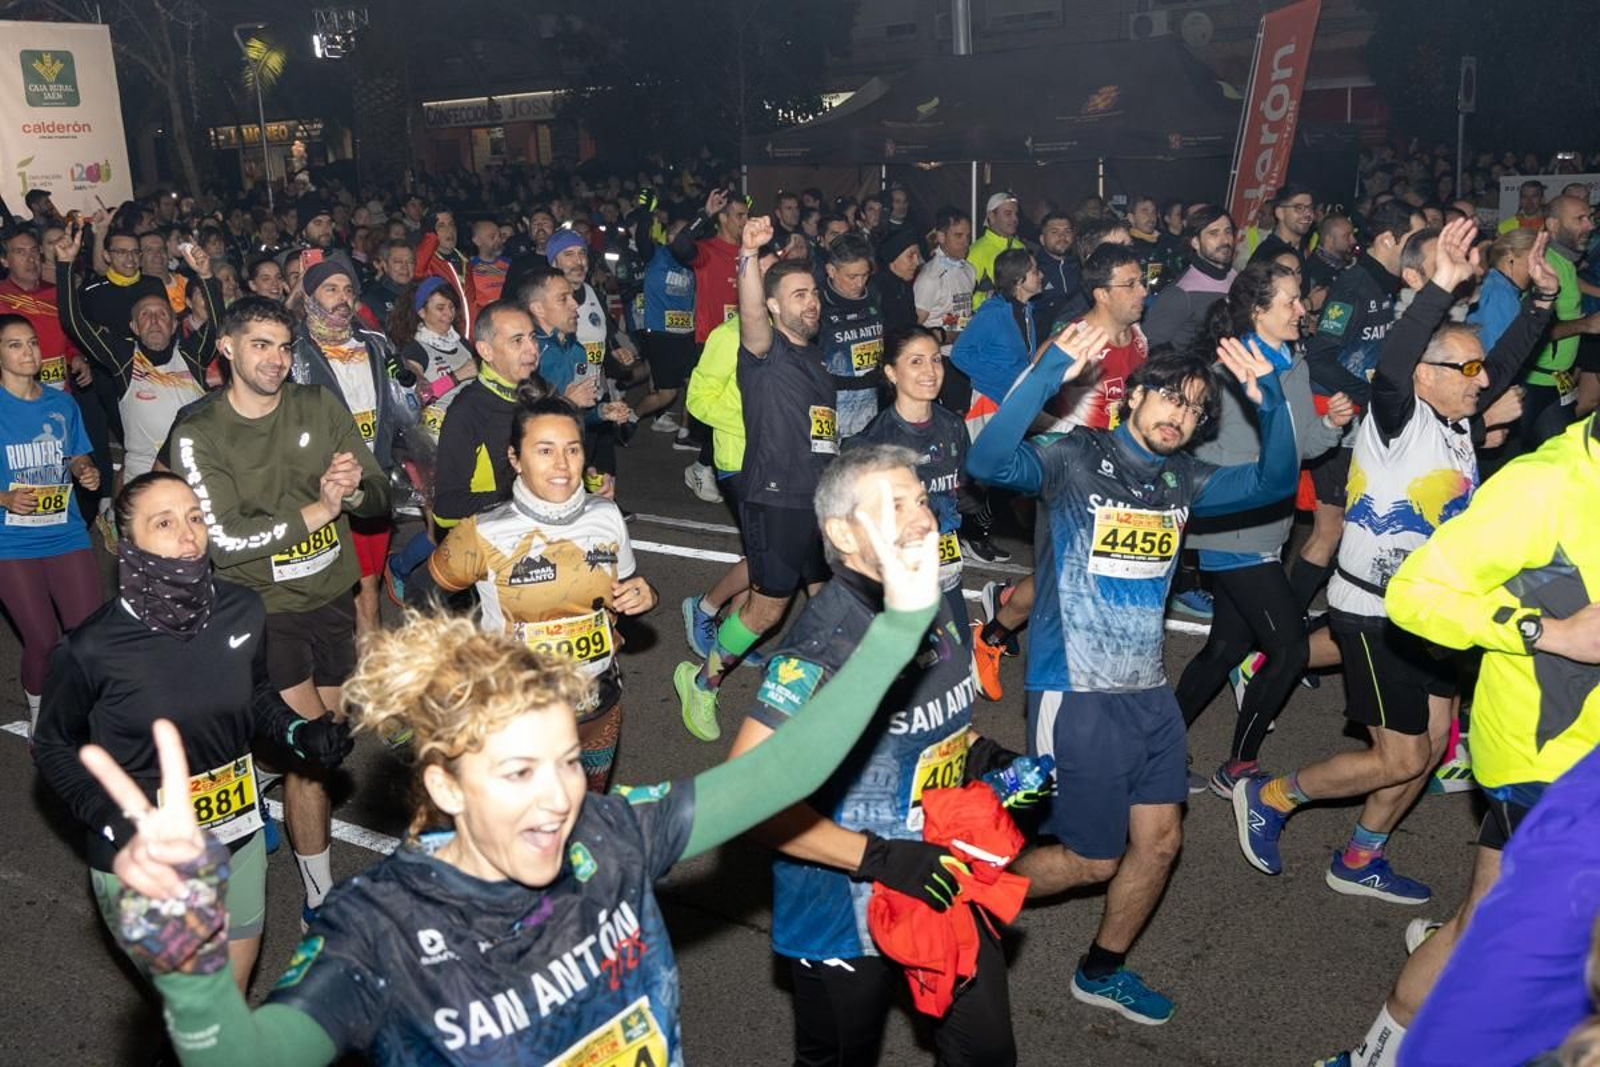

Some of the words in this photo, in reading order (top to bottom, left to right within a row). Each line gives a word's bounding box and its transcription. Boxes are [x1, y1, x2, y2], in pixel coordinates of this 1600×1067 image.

[22, 121, 91, 133] calderón
[6, 440, 64, 470] RUNNERS
[42, 495, 64, 510] 08
[1101, 528, 1172, 554] 4456
[524, 573, 555, 583] SANTO
[529, 566, 554, 575] TRAIL
[546, 624, 563, 636] 42
[889, 698, 944, 734] SAN
[194, 781, 246, 822] 881
[434, 988, 530, 1050] SAN
[530, 901, 641, 1017] ANTÓN
